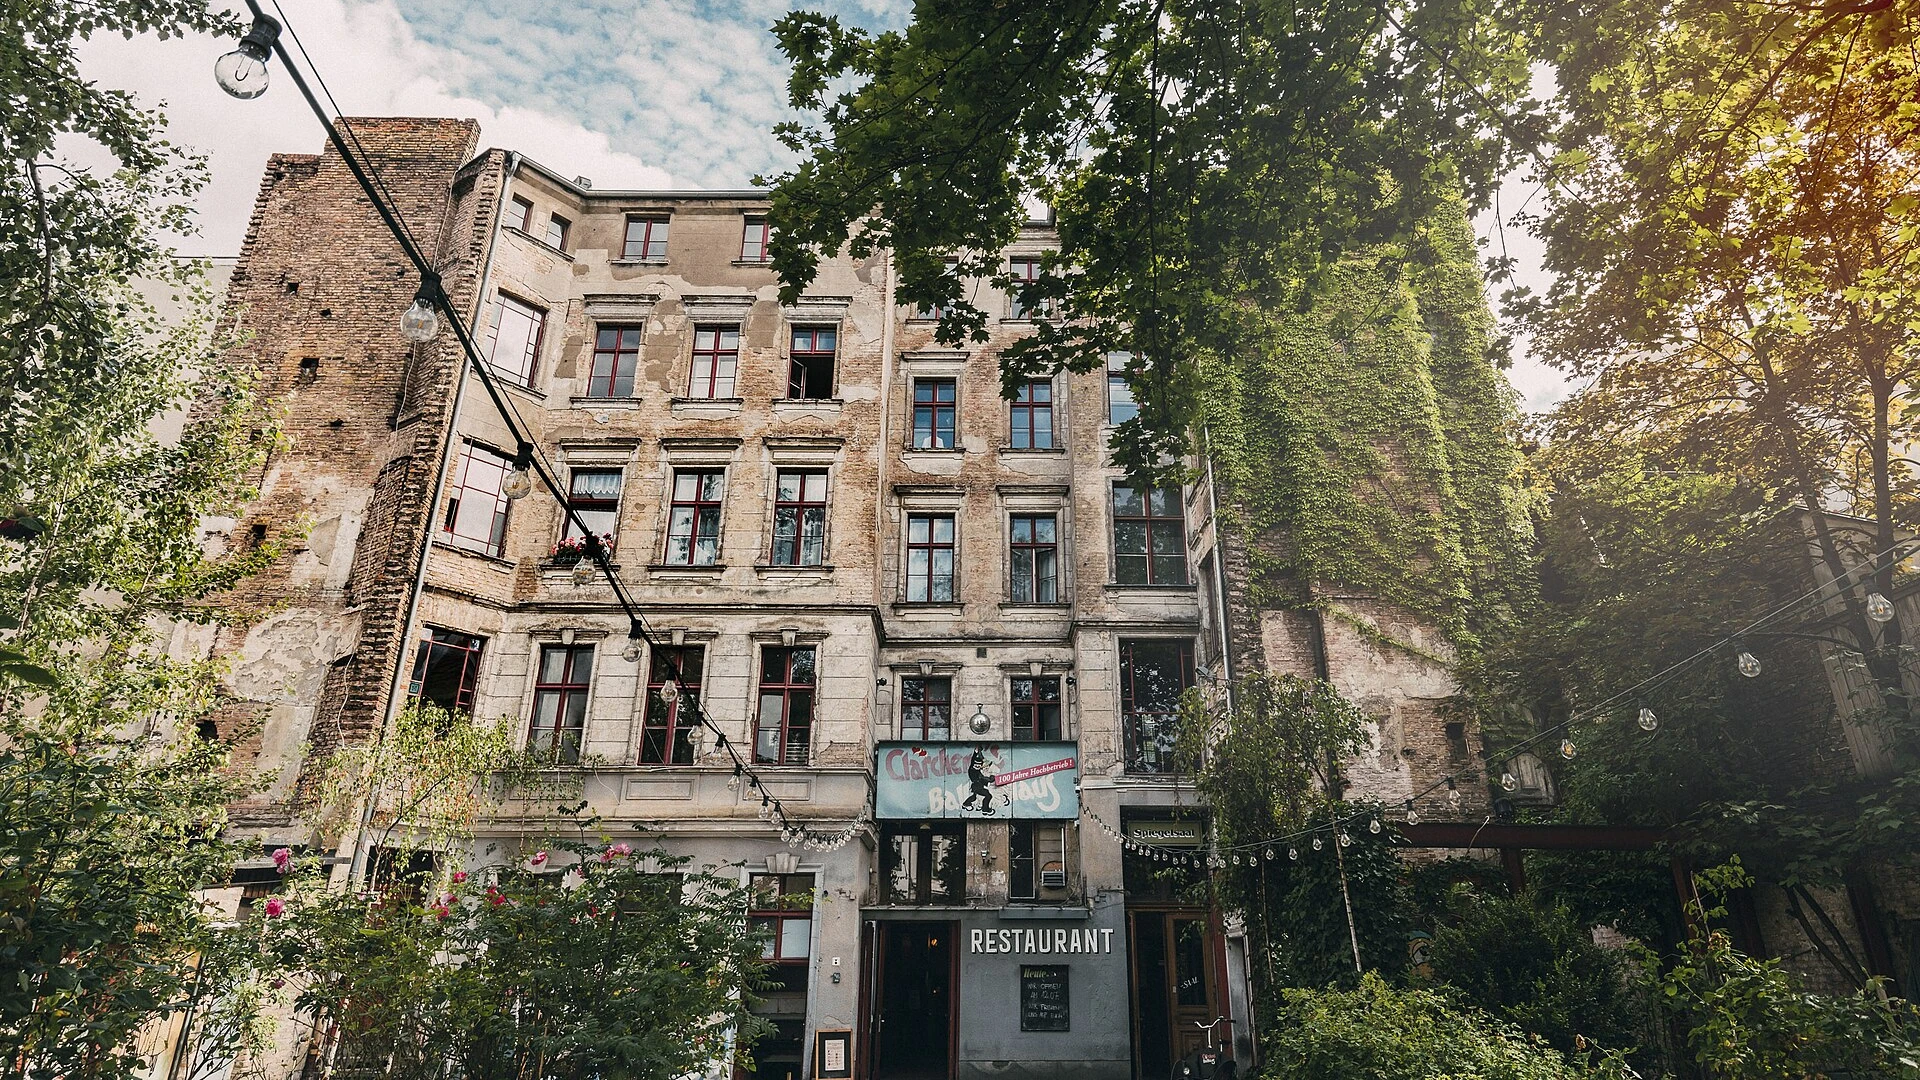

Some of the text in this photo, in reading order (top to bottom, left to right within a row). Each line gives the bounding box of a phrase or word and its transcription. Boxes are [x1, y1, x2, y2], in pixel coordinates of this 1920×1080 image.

[998, 774, 1011, 784] 100
[1011, 770, 1029, 782] Jahre
[1030, 760, 1069, 776] Hochbetrieb
[1133, 828, 1195, 840] Spiegelsaal
[970, 928, 1114, 954] RESTAURANT
